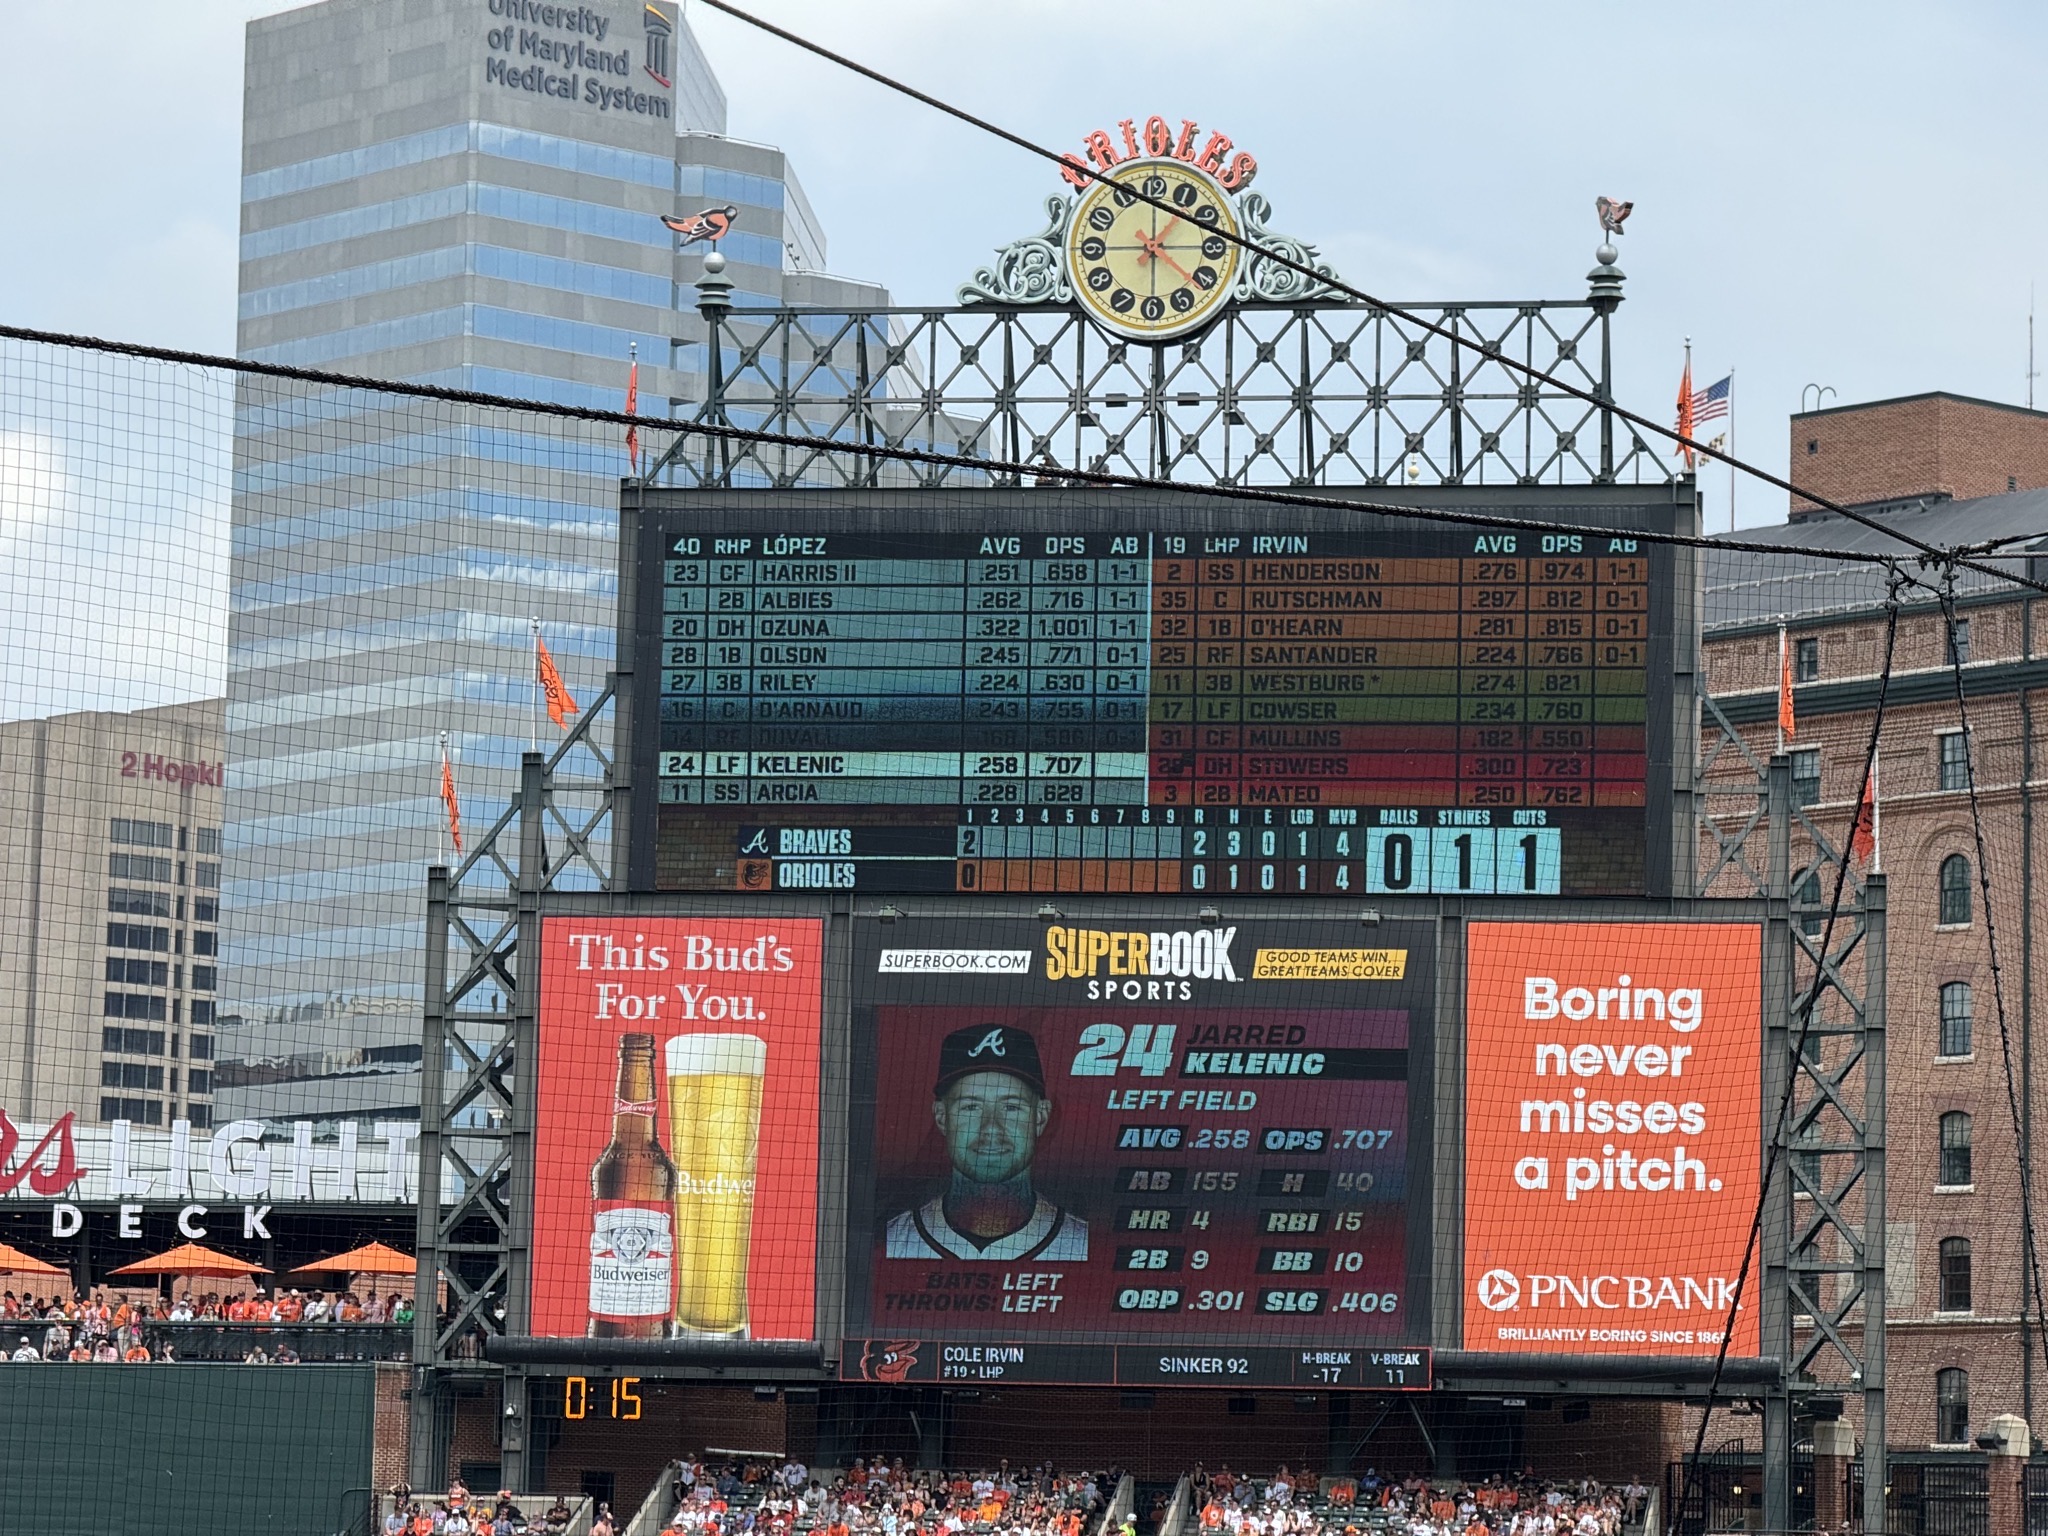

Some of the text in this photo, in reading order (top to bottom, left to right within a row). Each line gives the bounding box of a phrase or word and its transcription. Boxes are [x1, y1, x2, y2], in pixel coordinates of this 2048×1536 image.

[489, 0, 610, 41] University
[488, 27, 630, 76] of Maryland
[486, 56, 670, 118] Medical System
[1059, 116, 1257, 188] ORIOLES
[1144, 179, 1165, 193] 12
[1179, 187, 1189, 205] 1
[1115, 292, 1131, 307] 7
[1146, 299, 1157, 317] 6
[1176, 292, 1189, 309] 5
[674, 534, 1138, 555] 40 RHP LÓPEZ AVG OPS AB
[1164, 536, 1638, 554] 19 LHP IRVIN AVG OPS AB
[674, 565, 1137, 582] 23 CF HARRIS II .251 .658 1-1
[1252, 563, 1381, 581] HENDERSON
[761, 592, 833, 609] ALBIES
[1251, 591, 1382, 609] RUTSCHMAN
[761, 620, 830, 637] OZUNA
[1251, 618, 1343, 636] O'HEARN
[760, 647, 827, 664] OLSON
[1250, 646, 1378, 664] SANTANDER
[760, 674, 818, 691] RILEY
[121, 751, 224, 788] 2 Hopki
[668, 756, 1083, 774] 24 LF KELENIC .258 .707
[757, 784, 818, 801] ARCIA
[1248, 786, 1320, 803] MATEO
[967, 809, 1175, 823] 1 2 3 4 5 6 7 8 9
[1194, 809, 1357, 825] R H E LOB MVR
[1380, 809, 1547, 825] BALLS STRIKES OUTS
[779, 828, 976, 855] BRAVES 2
[1193, 830, 1349, 856] 2 3 0 1 4
[1384, 833, 1412, 890] 0
[1454, 834, 1471, 889] 1
[1520, 834, 1536, 890] 1
[779, 863, 976, 888] ORIOLES 0
[1192, 864, 1349, 890] 0 1 0 1 4
[569, 934, 669, 971] This
[885, 954, 1026, 968] SUPERBOOK.COM
[1046, 926, 1237, 983] SUPERBOOK
[1266, 951, 1391, 964] GOOD TEAMS WIN,
[1258, 965, 1400, 977] GREAT TEAMS COVER
[1087, 980, 1191, 1000] SPORTS
[595, 983, 766, 1021] For You.
[1524, 974, 1703, 1032] Boring
[1186, 1024, 1307, 1045] JARRED
[1071, 1023, 1177, 1077] 24
[1185, 1052, 1326, 1075] KELENIC
[1536, 1044, 1693, 1078] never
[1107, 1089, 1257, 1112] LEFT FIELD
[1520, 1087, 1706, 1135] misses
[1120, 1128, 1250, 1149] AVG .258
[1265, 1130, 1393, 1150] OPS .707
[111, 1118, 420, 1198] LIGHT
[1128, 1171, 1239, 1191] AB 155
[1282, 1172, 1374, 1192] H 40
[1514, 1144, 1723, 1201] a pitch.
[52, 1204, 272, 1239] DECK
[1128, 1210, 1210, 1230] HR 4
[1267, 1212, 1364, 1231] RBI 15
[1128, 1249, 1210, 1269] 2B 9
[1272, 1251, 1364, 1272] BB 10
[593, 1265, 669, 1281] Budweiser
[927, 1273, 1063, 1291] BATS: LEFT
[885, 1293, 1063, 1313] THROWS: LEFT
[1119, 1289, 1244, 1310] OBP .301
[1265, 1292, 1398, 1312] SLG .406
[1497, 1328, 1586, 1341] BRILLIANTLY
[1590, 1329, 1647, 1342] BORING
[1650, 1330, 1693, 1344] SINCE
[944, 1347, 1024, 1363] COLE IRVIN
[1302, 1353, 1351, 1364] H-BREAK
[1371, 1353, 1420, 1365] V-BREAK
[944, 1365, 1004, 1378] #19 LHP
[1160, 1357, 1248, 1374] SINKER 92
[1313, 1368, 1342, 1384] -17
[1386, 1370, 1404, 1384] 11
